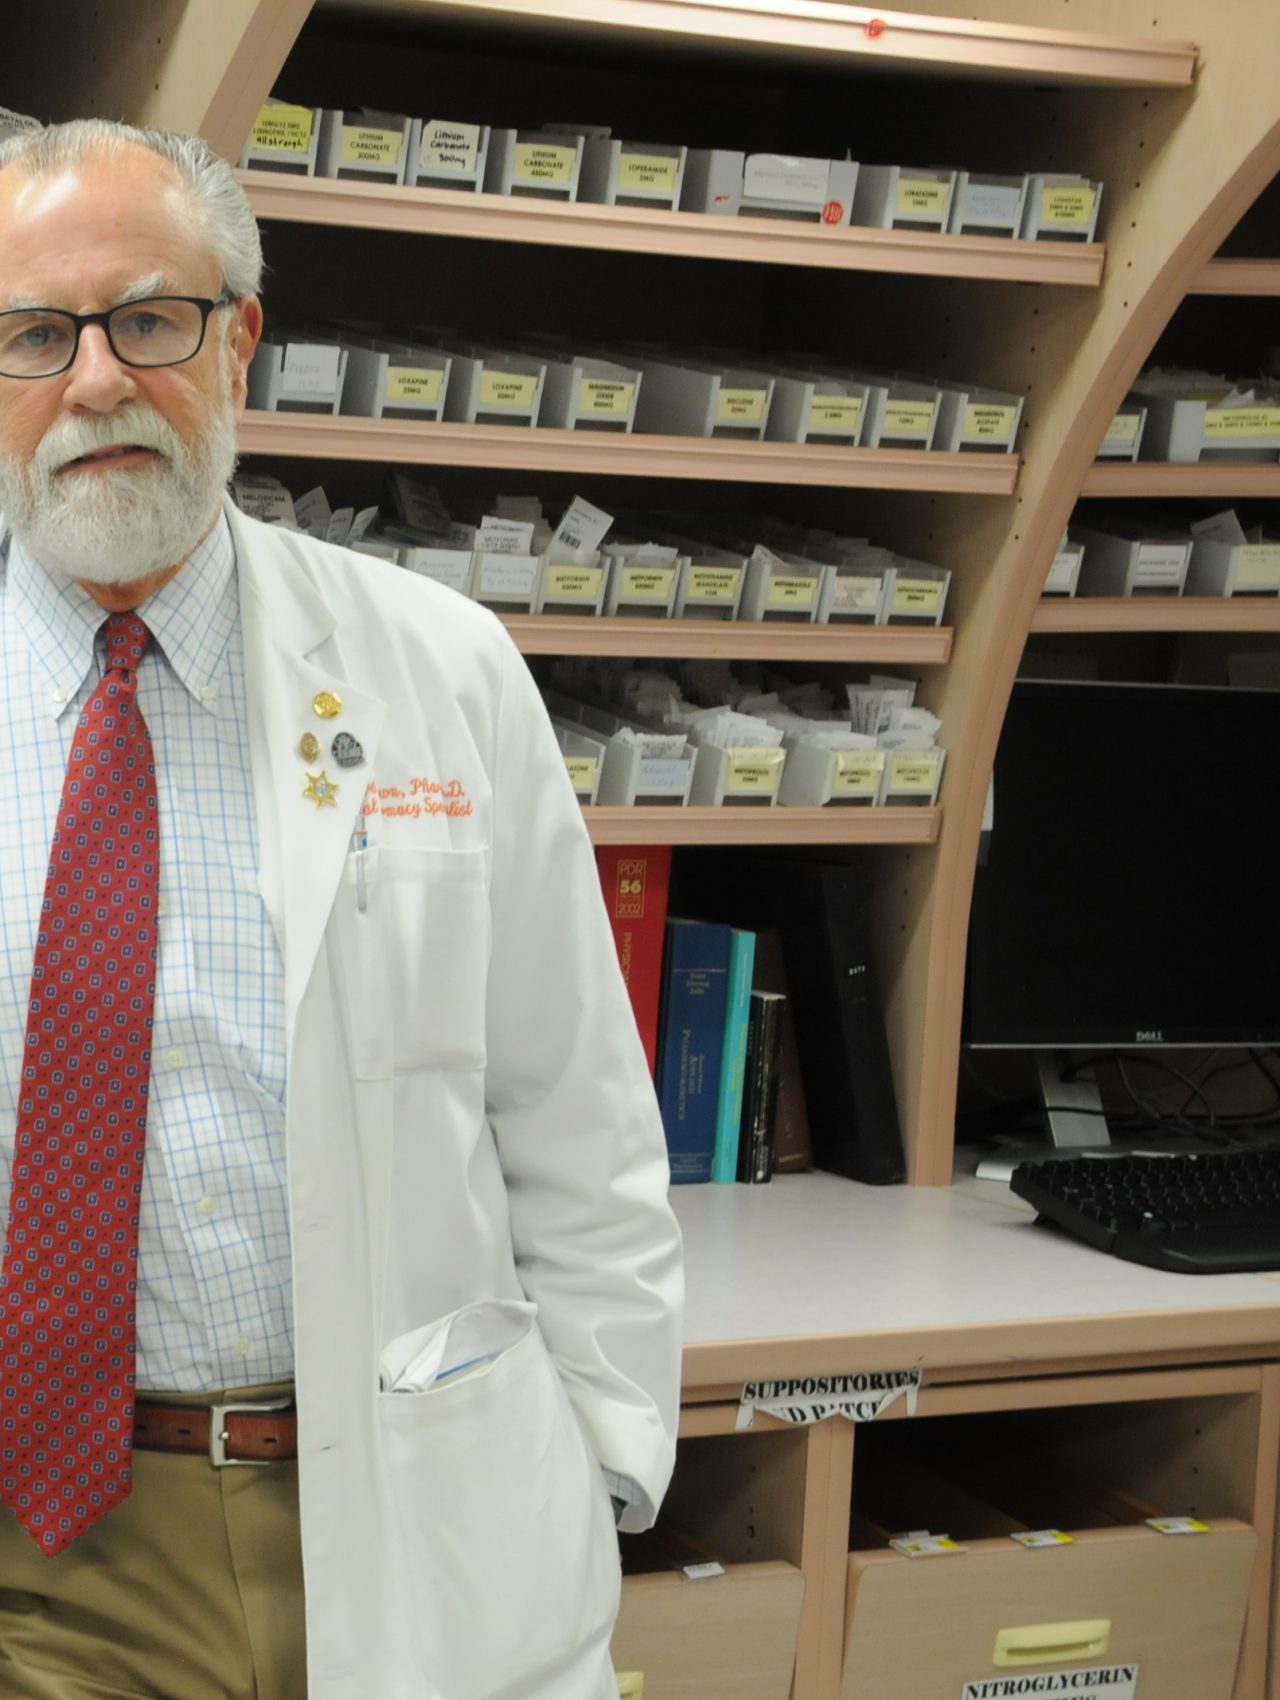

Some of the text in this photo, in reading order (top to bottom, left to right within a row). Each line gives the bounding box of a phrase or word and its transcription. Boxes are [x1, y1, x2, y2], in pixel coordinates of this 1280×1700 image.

[358, 132, 384, 141] LITHIUM
[434, 130, 465, 141] Lithium
[350, 140, 390, 152] CARBONATE
[532, 150, 557, 160] LITHIUM
[524, 158, 564, 170] CARBONATE
[628, 163, 668, 174] LOPERAMIDE
[398, 377, 429, 386] LOXAPINE
[492, 383, 523, 392] LOXAPINE
[620, 862, 643, 876] PDR
[620, 880, 642, 894] 56
[618, 903, 642, 915] 2002
[1136, 1031, 1164, 1041] DELL
[743, 1370, 920, 1400] SUPPOSITORIES
[966, 1666, 1136, 1700] NITROGLYCERIN
